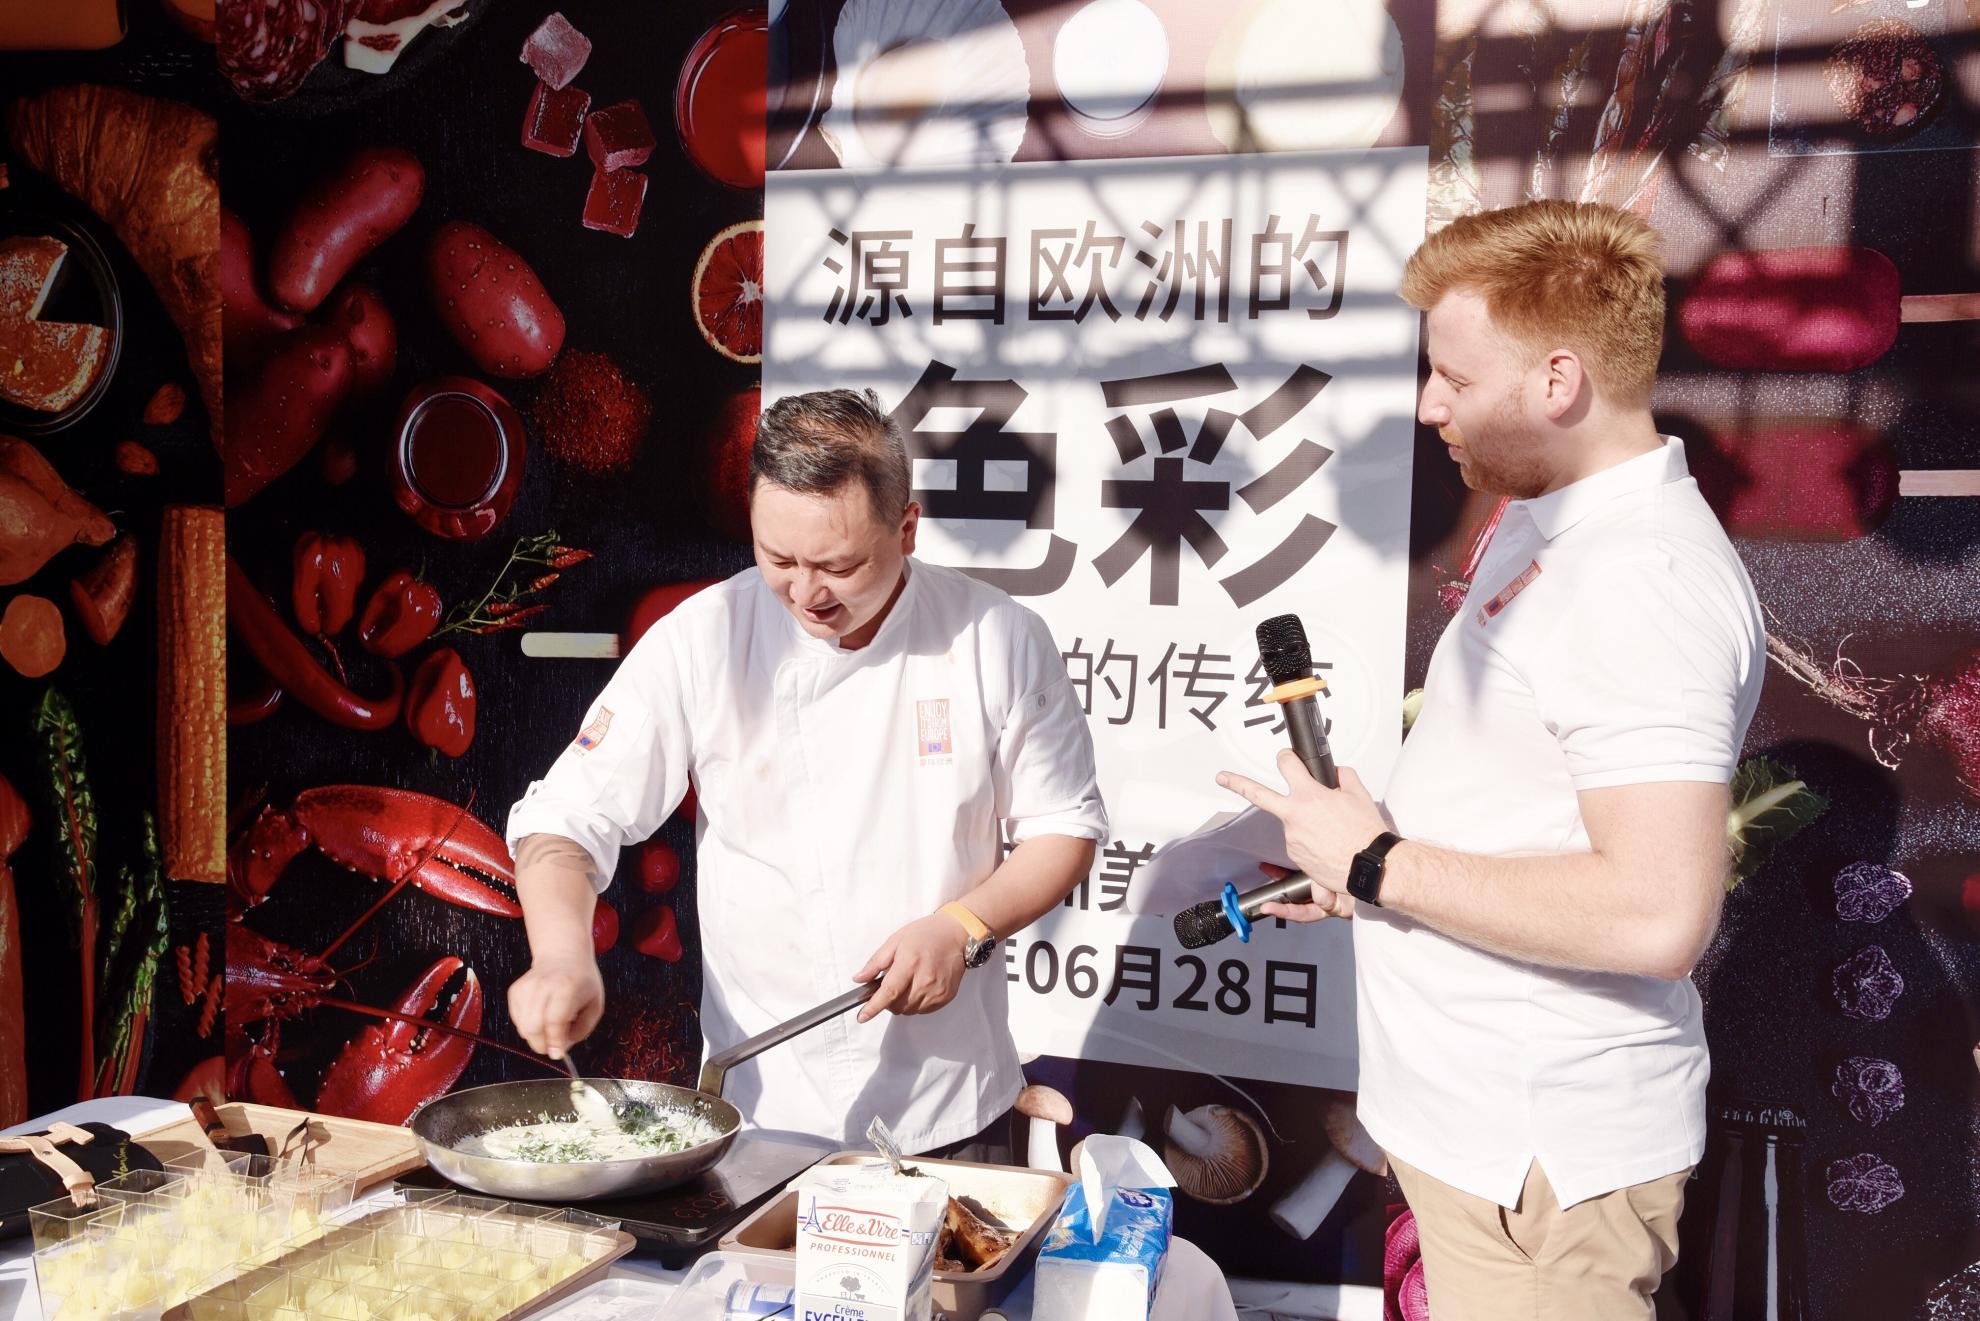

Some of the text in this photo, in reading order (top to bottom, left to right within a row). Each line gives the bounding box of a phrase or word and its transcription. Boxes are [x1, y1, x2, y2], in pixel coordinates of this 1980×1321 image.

[822, 214, 1349, 326] 源自欧洲的
[890, 359, 1338, 608] 色彩
[810, 1242, 896, 1262] PROFESSIONNEL
[834, 1303, 865, 1317] Crème
